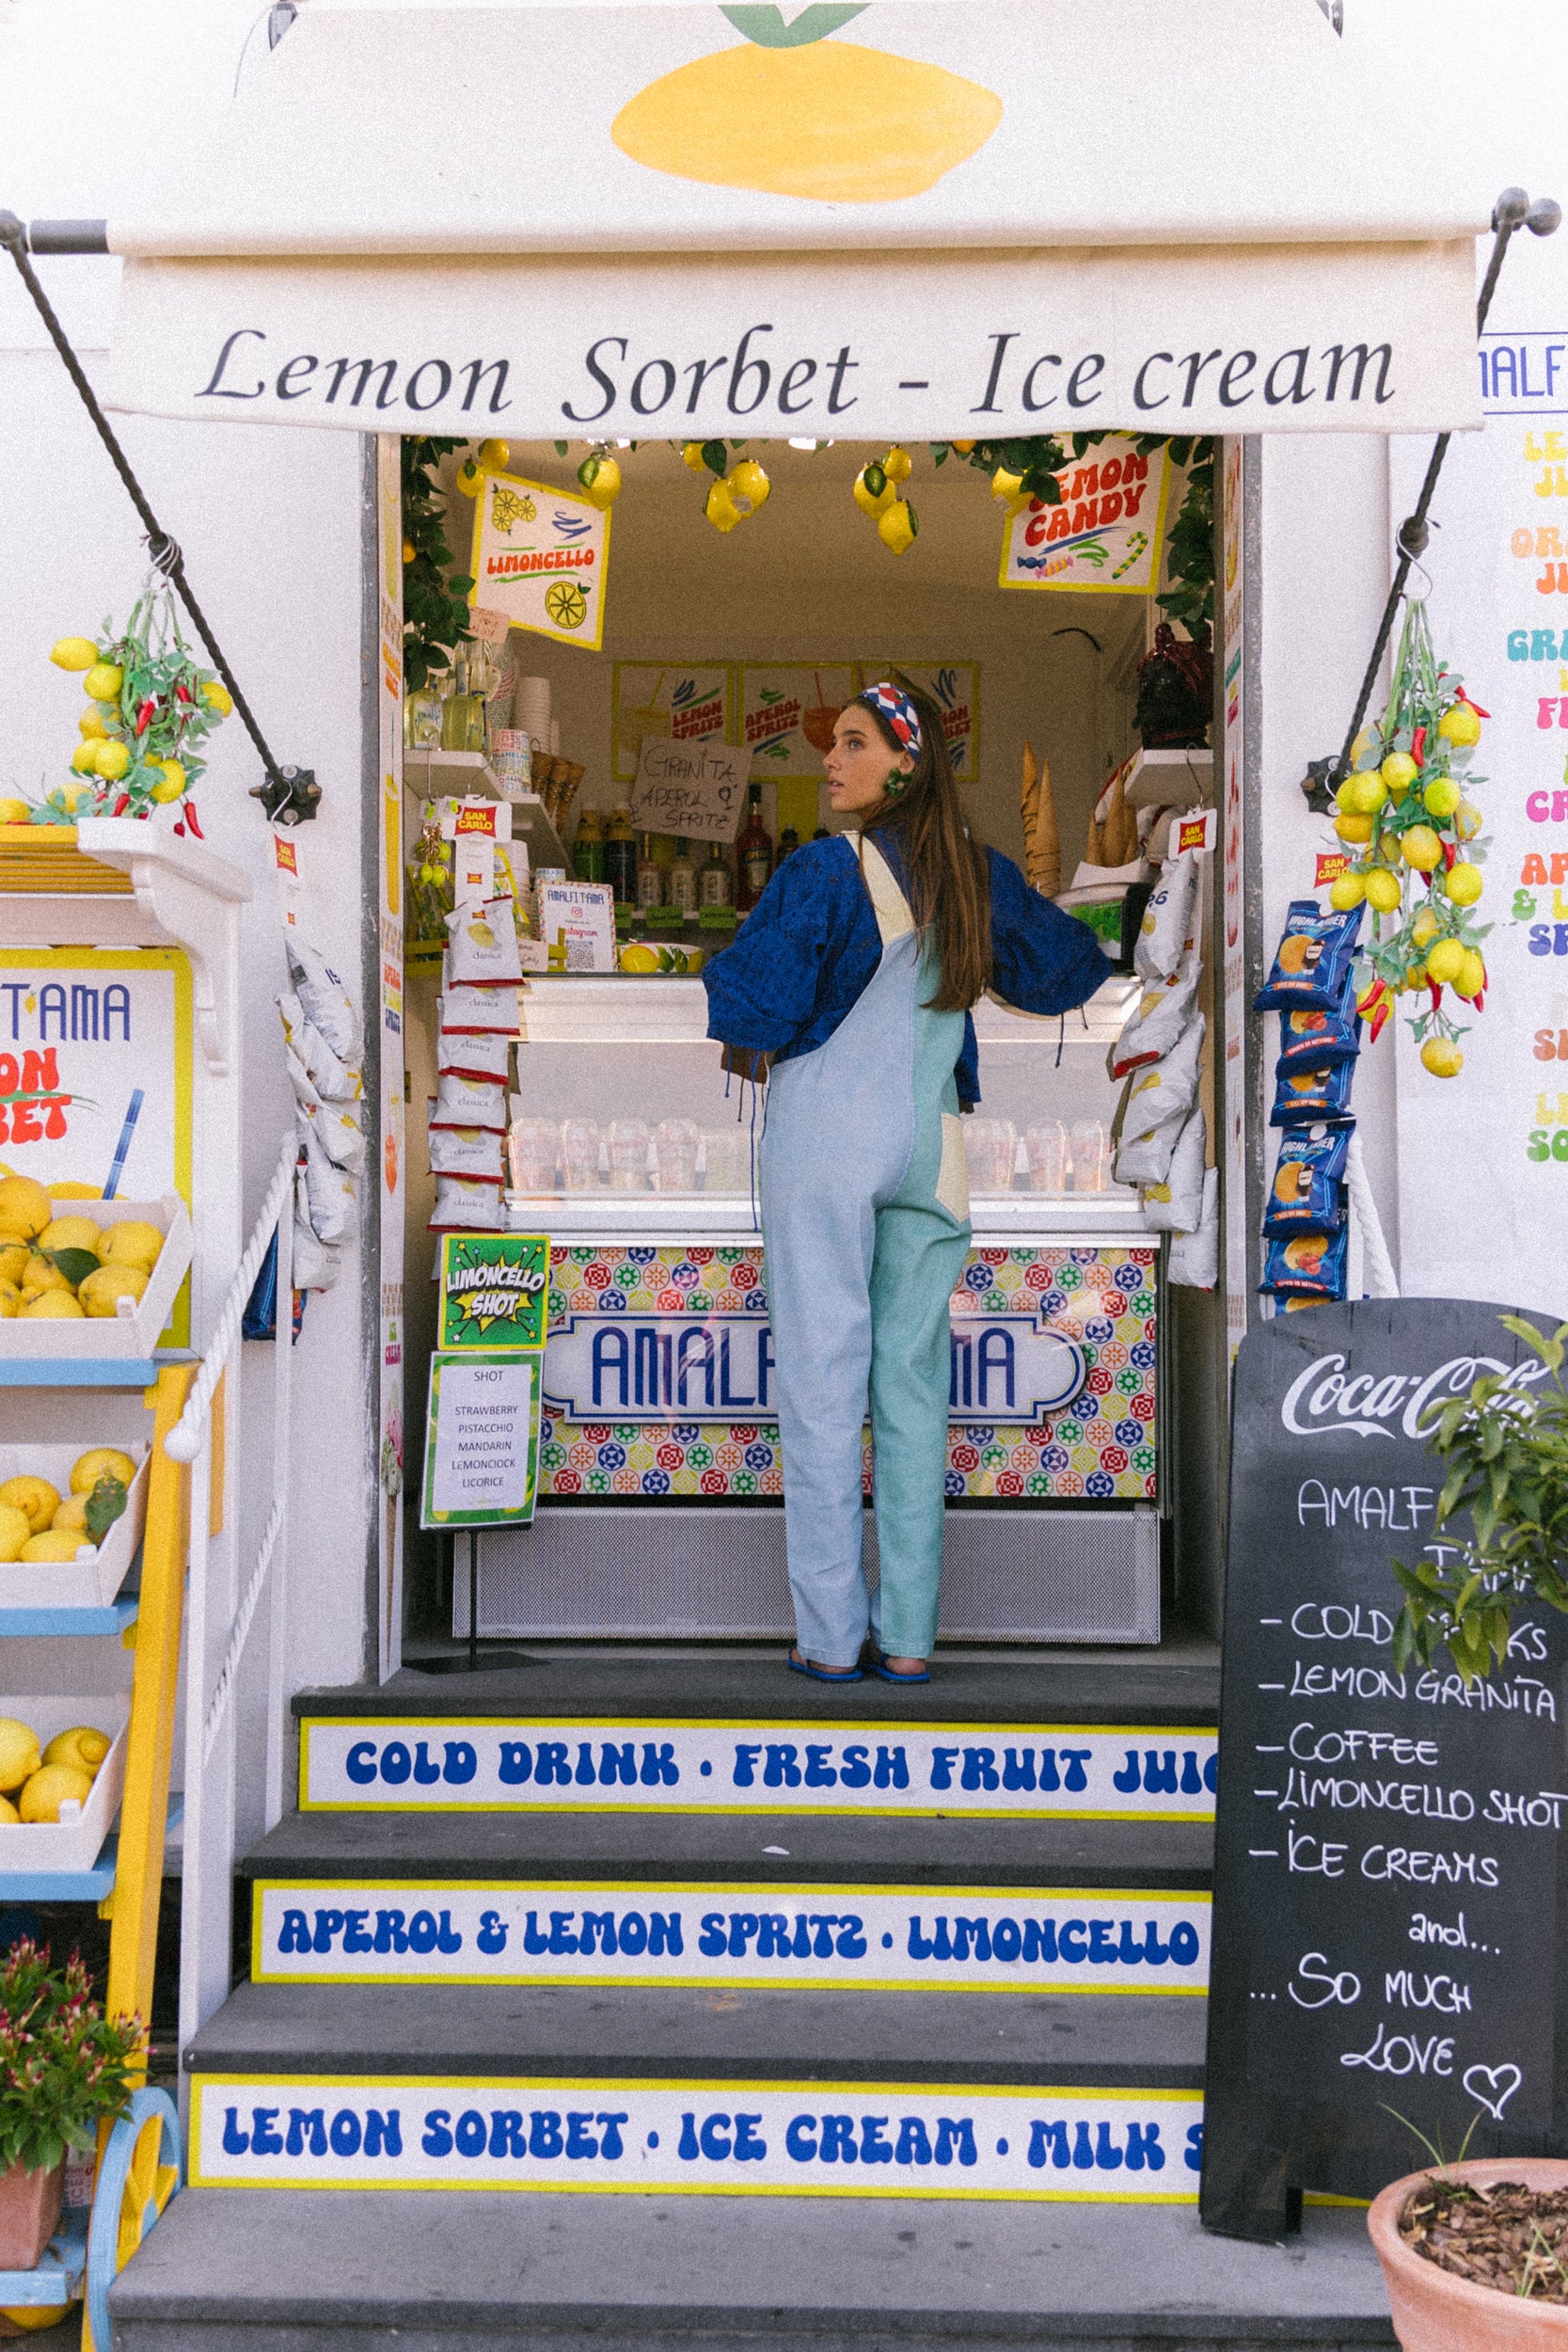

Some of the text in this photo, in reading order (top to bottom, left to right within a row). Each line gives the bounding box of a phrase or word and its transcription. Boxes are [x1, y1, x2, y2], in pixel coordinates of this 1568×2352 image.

[196, 329, 512, 413] Lemon
[561, 323, 860, 421] Sorbet
[969, 332, 1105, 413] Ice
[1132, 342, 1395, 411] cream
[1024, 483, 1148, 548] CANDY
[1510, 527, 1568, 558] OR
[486, 548, 594, 575] LIMONCELLO
[465, 810, 487, 822] SAN
[457, 819, 494, 831] CARLO
[1184, 825, 1200, 836] SAN
[1180, 833, 1205, 847] CARLO
[1323, 857, 1345, 869] SAN
[547, 889, 578, 903] AMALFI
[1512, 889, 1538, 921] &
[472, 951, 502, 960] classica
[468, 998, 499, 1008] classica
[460, 1039, 491, 1053] classica
[457, 1096, 489, 1107] classica
[453, 1147, 484, 1156] classica
[453, 1198, 484, 1208] classica
[447, 1265, 546, 1293] LIMONCELLO
[471, 1292, 519, 1317] SHOT
[473, 1370, 504, 1383] SHOT
[454, 1405, 518, 1416] STRAWBERRY
[458, 1422, 514, 1434] PISTACCHIO
[457, 1440, 513, 1452] MANDARIN
[451, 1458, 516, 1470] LEMONCIOCK
[462, 1476, 504, 1488] LICORICE
[1291, 1602, 1395, 1645] COLD
[1290, 1660, 1407, 1700] LEMON
[1414, 1669, 1558, 1724] GRANITA
[1289, 1722, 1439, 1765] COFFEE
[346, 1741, 477, 1785] COLD
[499, 1741, 680, 1787] DRINK
[733, 1744, 910, 1789] FRESH
[930, 1747, 1092, 1792] FRUIT
[1278, 1768, 1476, 1821] LIMONCELLO
[1481, 1790, 1568, 1829] SHOT
[1360, 1844, 1499, 1887] CREAMS
[277, 1909, 462, 1954] APEROL
[476, 1911, 509, 1955] &
[523, 1911, 684, 1957] LEMON
[698, 1913, 867, 1959] SPRITZ
[908, 1915, 1199, 1966] LIMONCELLO
[1385, 1969, 1472, 2013] MUCH
[223, 2107, 403, 2157] LEMON
[421, 2109, 628, 2160] SORBET
[678, 2113, 767, 2162] ICE
[785, 2114, 977, 2167] CREAM
[1027, 2120, 1165, 2171] MILK
